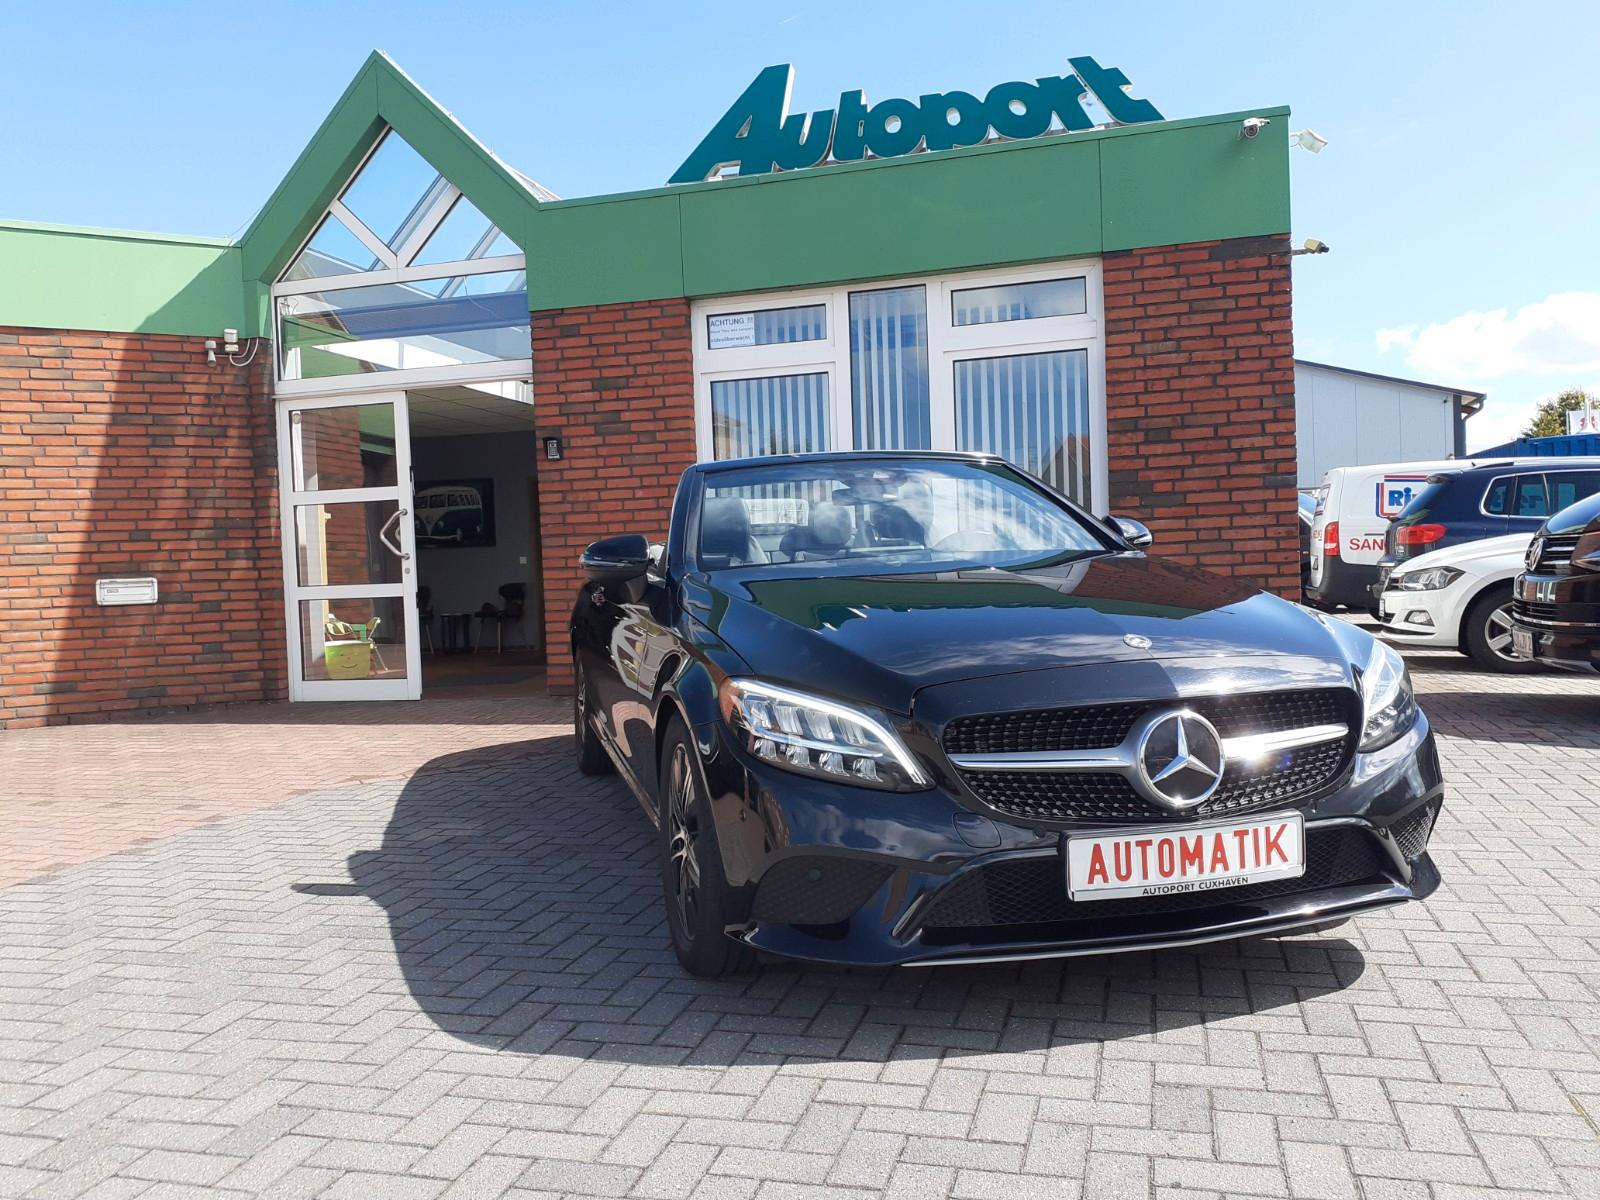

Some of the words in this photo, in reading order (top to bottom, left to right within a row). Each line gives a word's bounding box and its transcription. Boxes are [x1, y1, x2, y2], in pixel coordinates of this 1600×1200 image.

[666, 55, 1165, 185] Autoport
[710, 318, 744, 327] ACHTUNG
[1388, 486, 1417, 507] Ri
[1087, 823, 1289, 885] AUTOMATIK
[1142, 882, 1195, 896] AUTOPORT
[1198, 876, 1249, 889] CUXHAVEN
